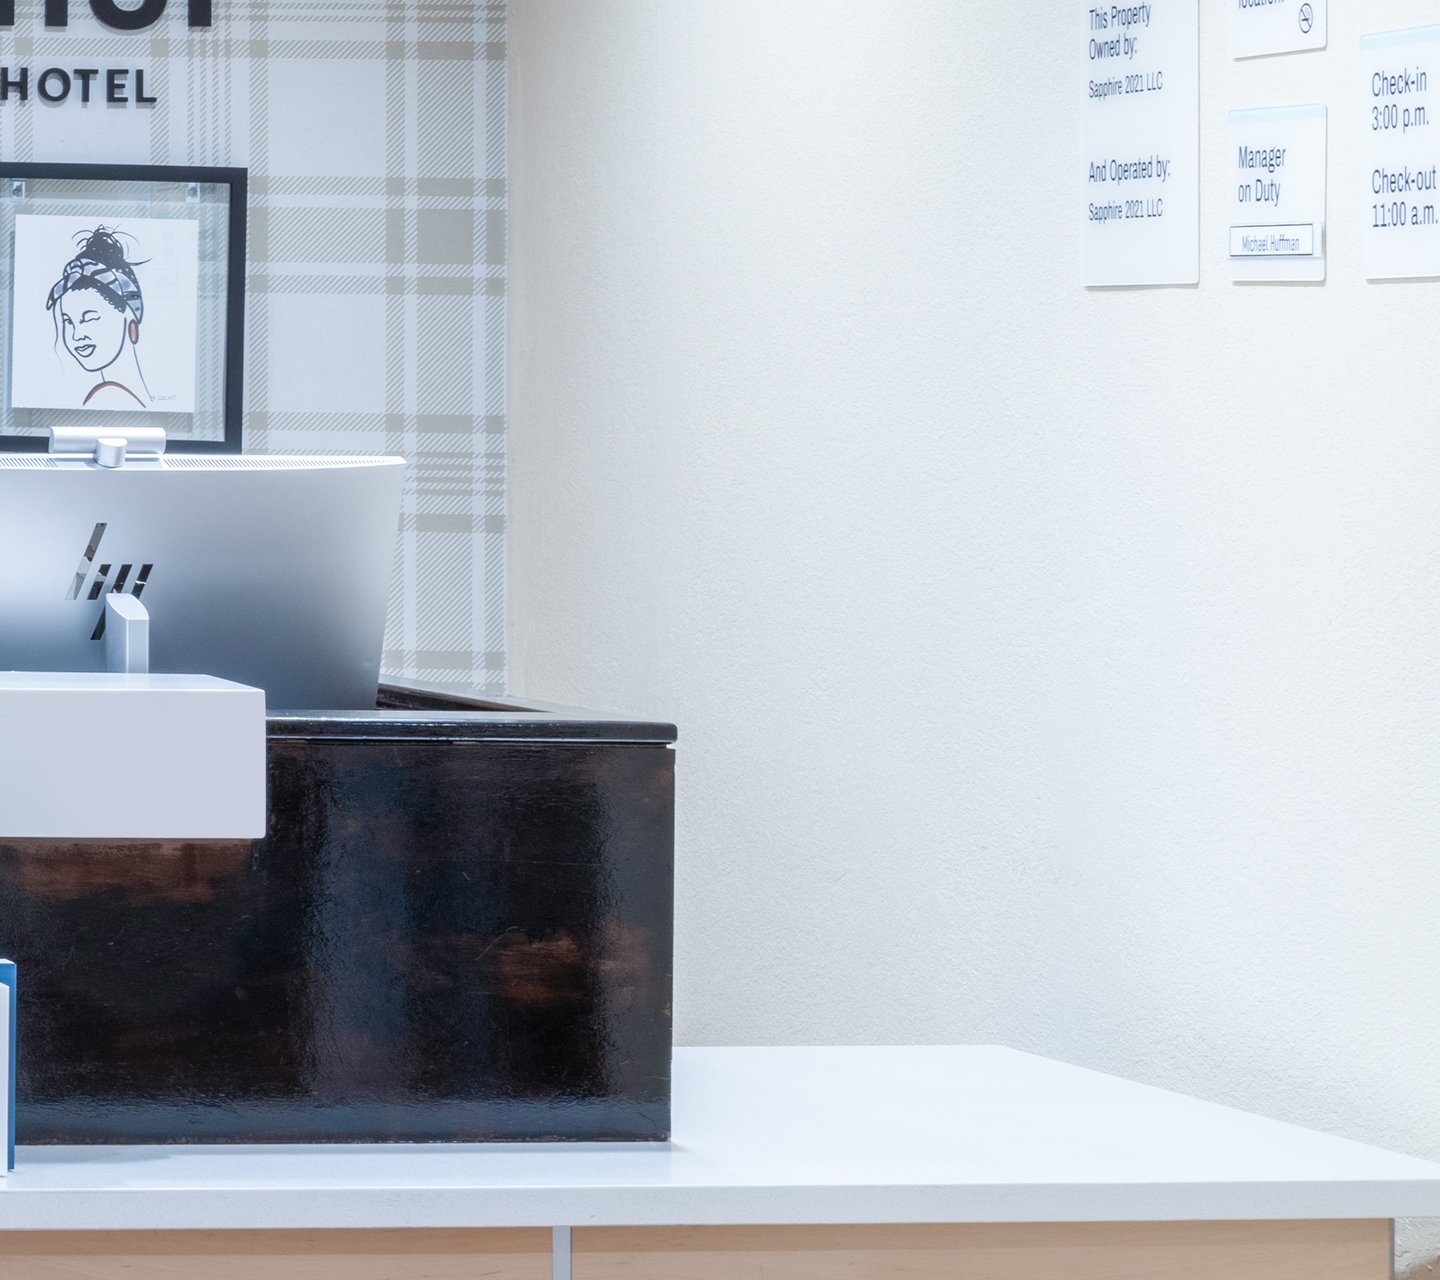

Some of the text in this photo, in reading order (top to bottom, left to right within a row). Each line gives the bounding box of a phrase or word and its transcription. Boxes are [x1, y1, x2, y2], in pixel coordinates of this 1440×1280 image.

[1089, 1, 1151, 32] This Property
[1089, 33, 1138, 60] Owned by:
[0, 67, 158, 104] HOTEL
[1089, 71, 1163, 100] Sapphire 2021 LLC
[1372, 67, 1428, 98] Check-in
[1372, 104, 1429, 133] 3:00 p.m.
[1089, 155, 1171, 186] And Operated by:
[1238, 146, 1286, 173] Manager
[1238, 178, 1281, 207] on Duty
[1372, 167, 1437, 195] Check-out
[1089, 198, 1163, 223] Sapphire 2021 LLC
[1372, 201, 1439, 228] 11:00 a.m.
[1242, 234, 1268, 252] Michael
